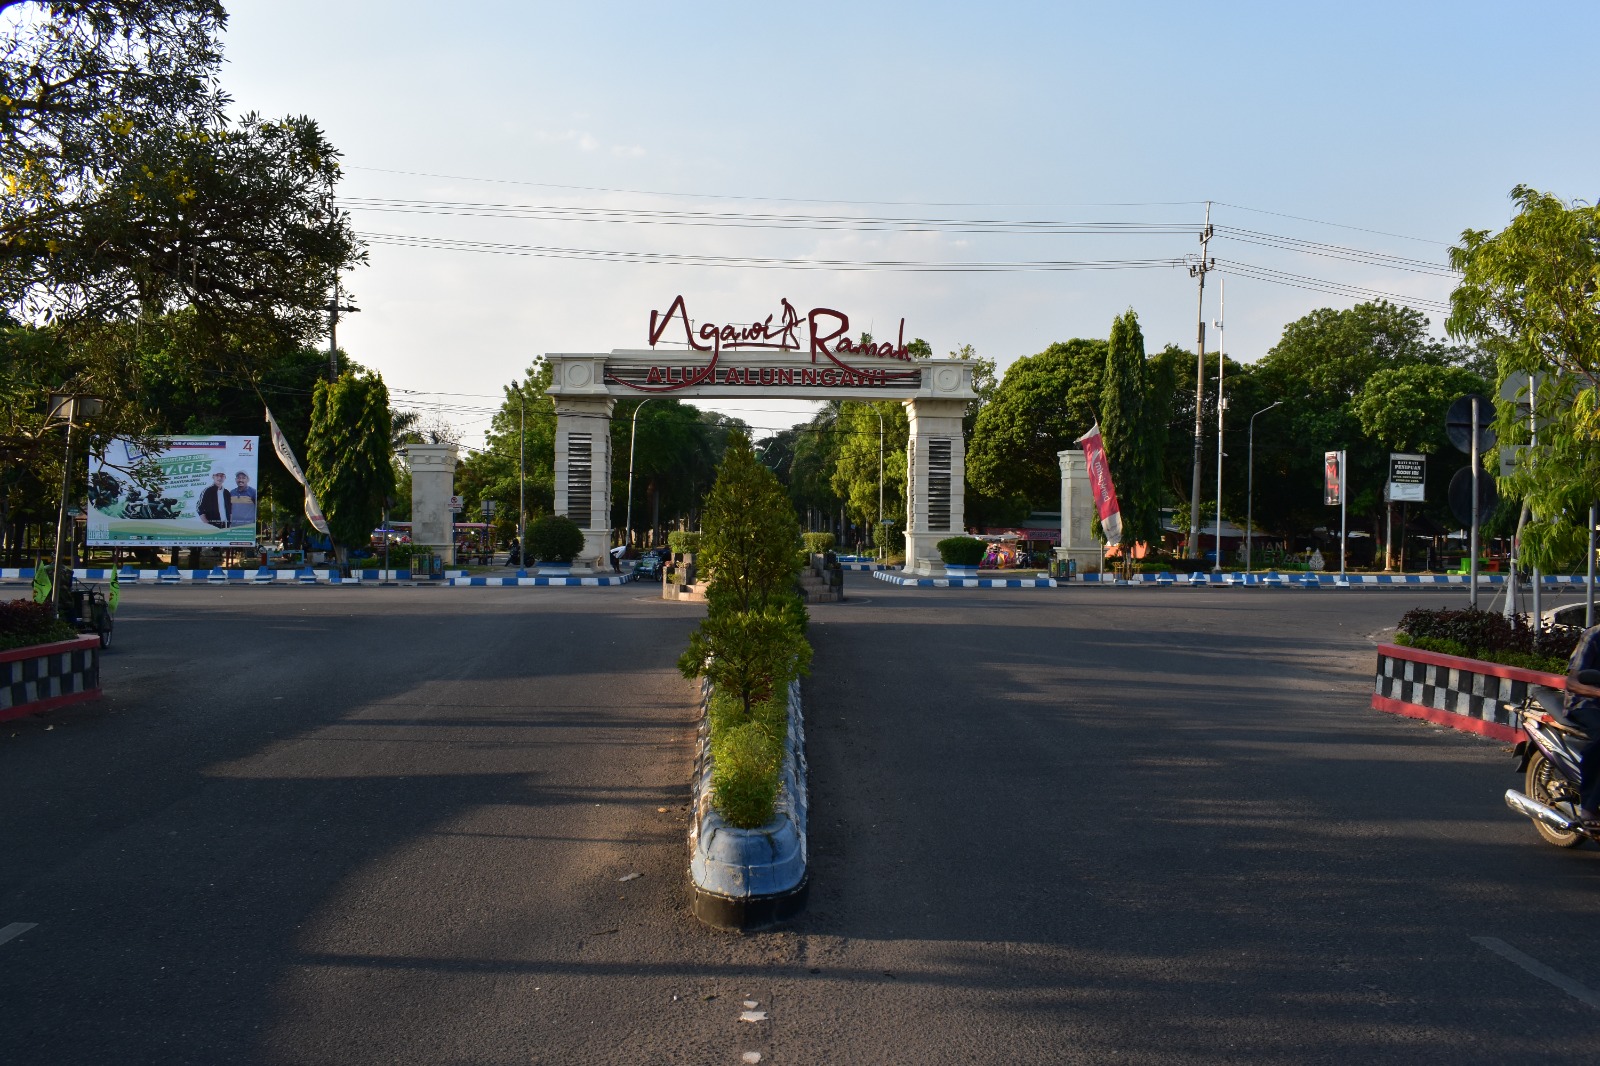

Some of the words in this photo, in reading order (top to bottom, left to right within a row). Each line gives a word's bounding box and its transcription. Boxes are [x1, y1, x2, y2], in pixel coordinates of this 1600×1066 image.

[808, 308, 912, 370] Ramah
[646, 366, 717, 385] ALUN
[724, 367, 794, 386] ALUN
[801, 368, 886, 387] NGAWI
[157, 461, 213, 476] TAGES
